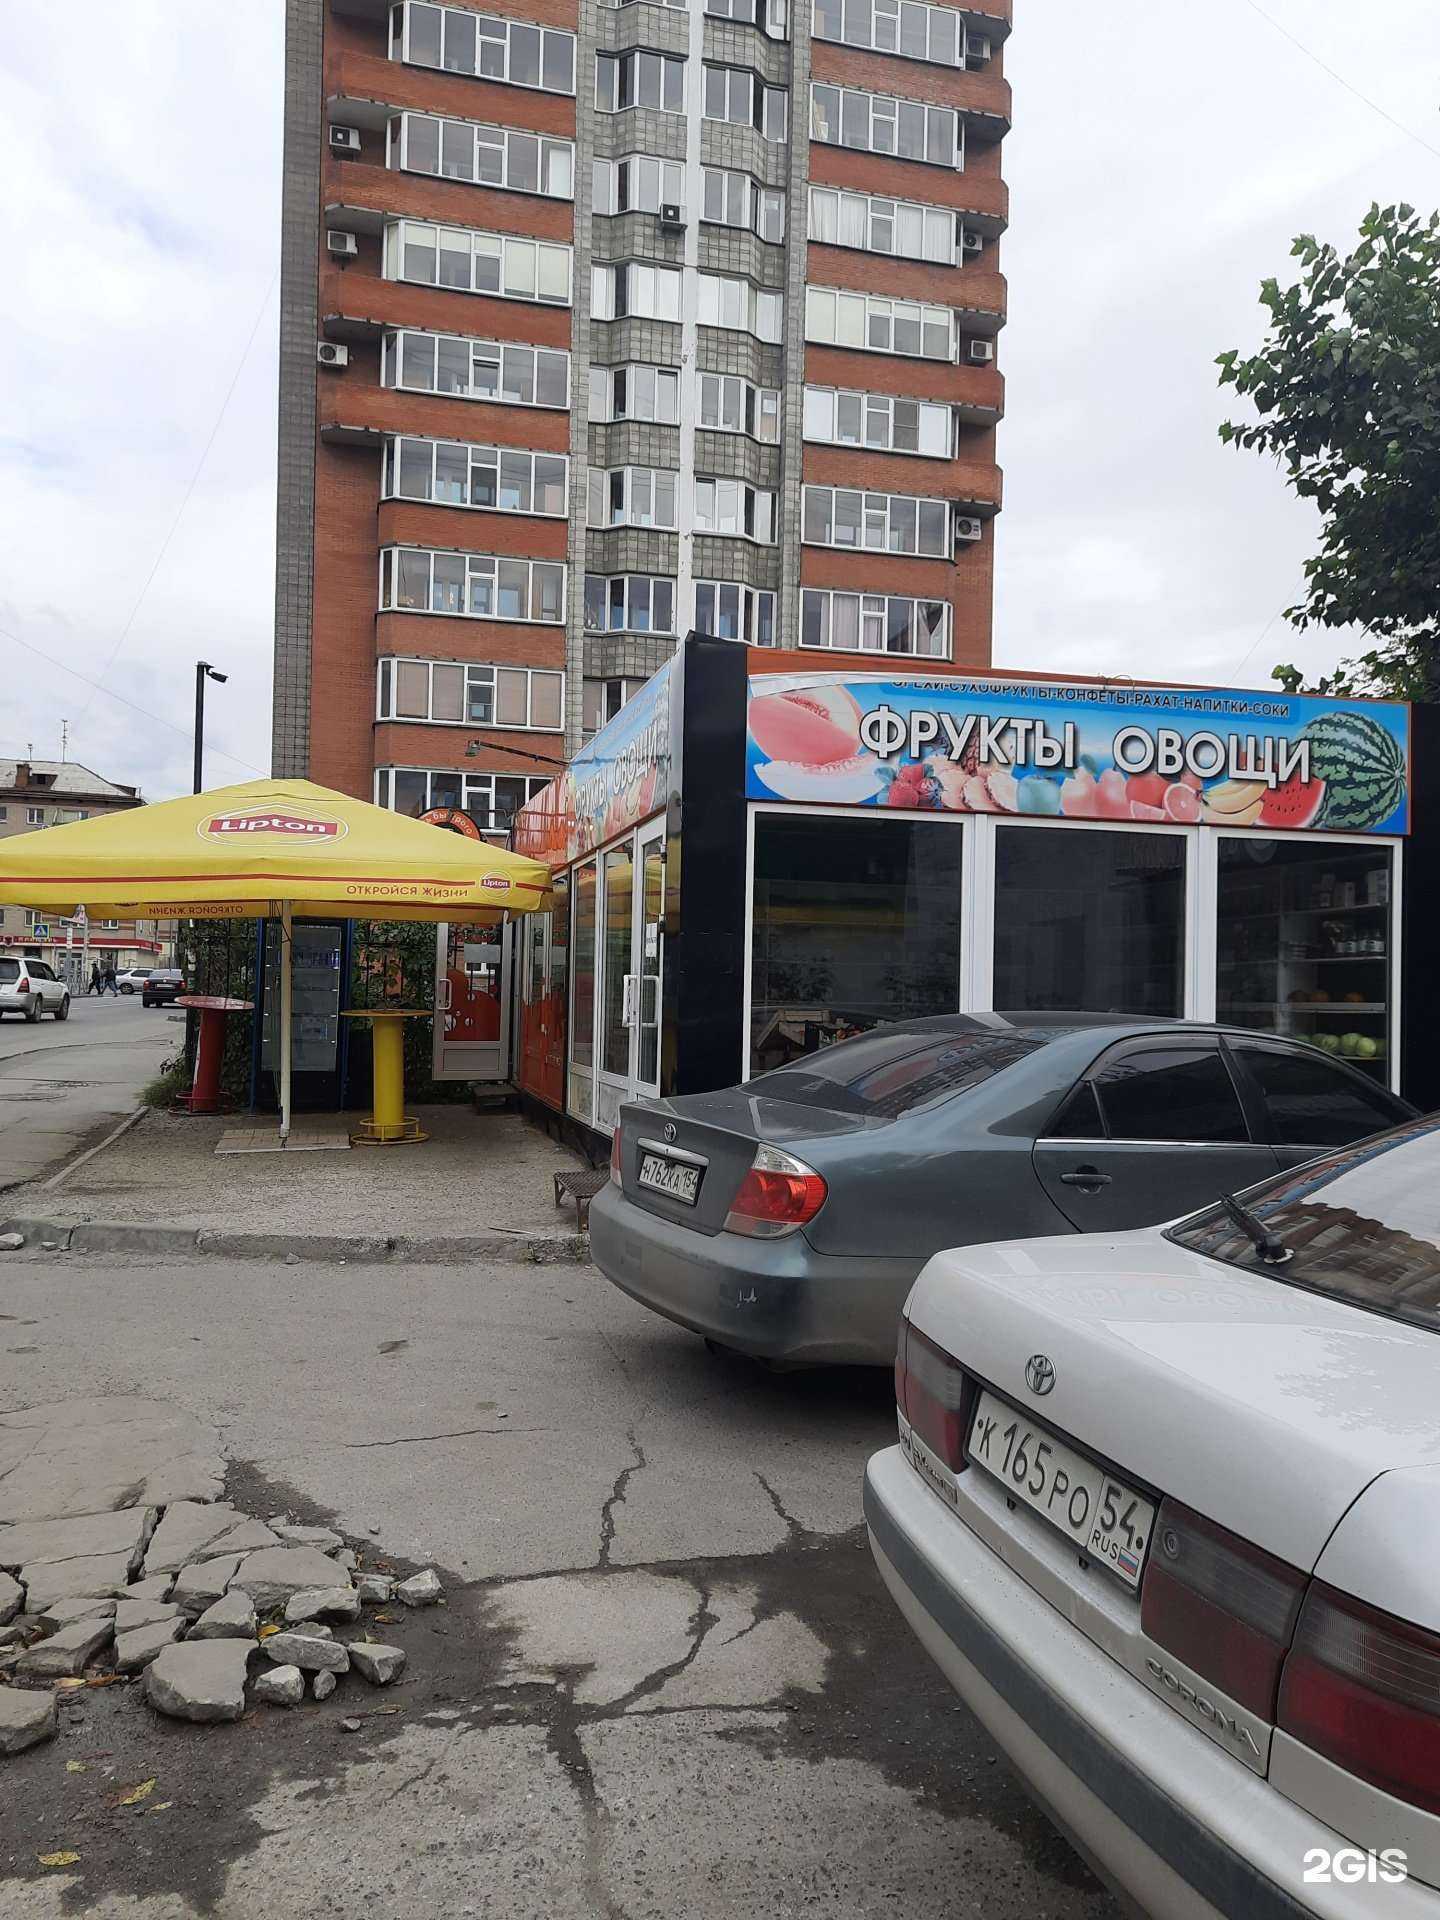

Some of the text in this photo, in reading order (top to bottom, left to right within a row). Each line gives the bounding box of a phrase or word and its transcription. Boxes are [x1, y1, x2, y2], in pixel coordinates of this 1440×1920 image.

[613, 720, 658, 794] ОВОЩИ
[858, 704, 1311, 788] ФРУКТЫ ОВОЩИ
[220, 818, 326, 832] Lipton
[346, 885, 468, 897] ОТКРОЙСЯ ЖИЗНИ
[483, 879, 509, 889] Lipton
[1099, 1486, 1137, 1549] 54
[1091, 1529, 1119, 1560] RUS
[1145, 1657, 1262, 1757] CORONA
